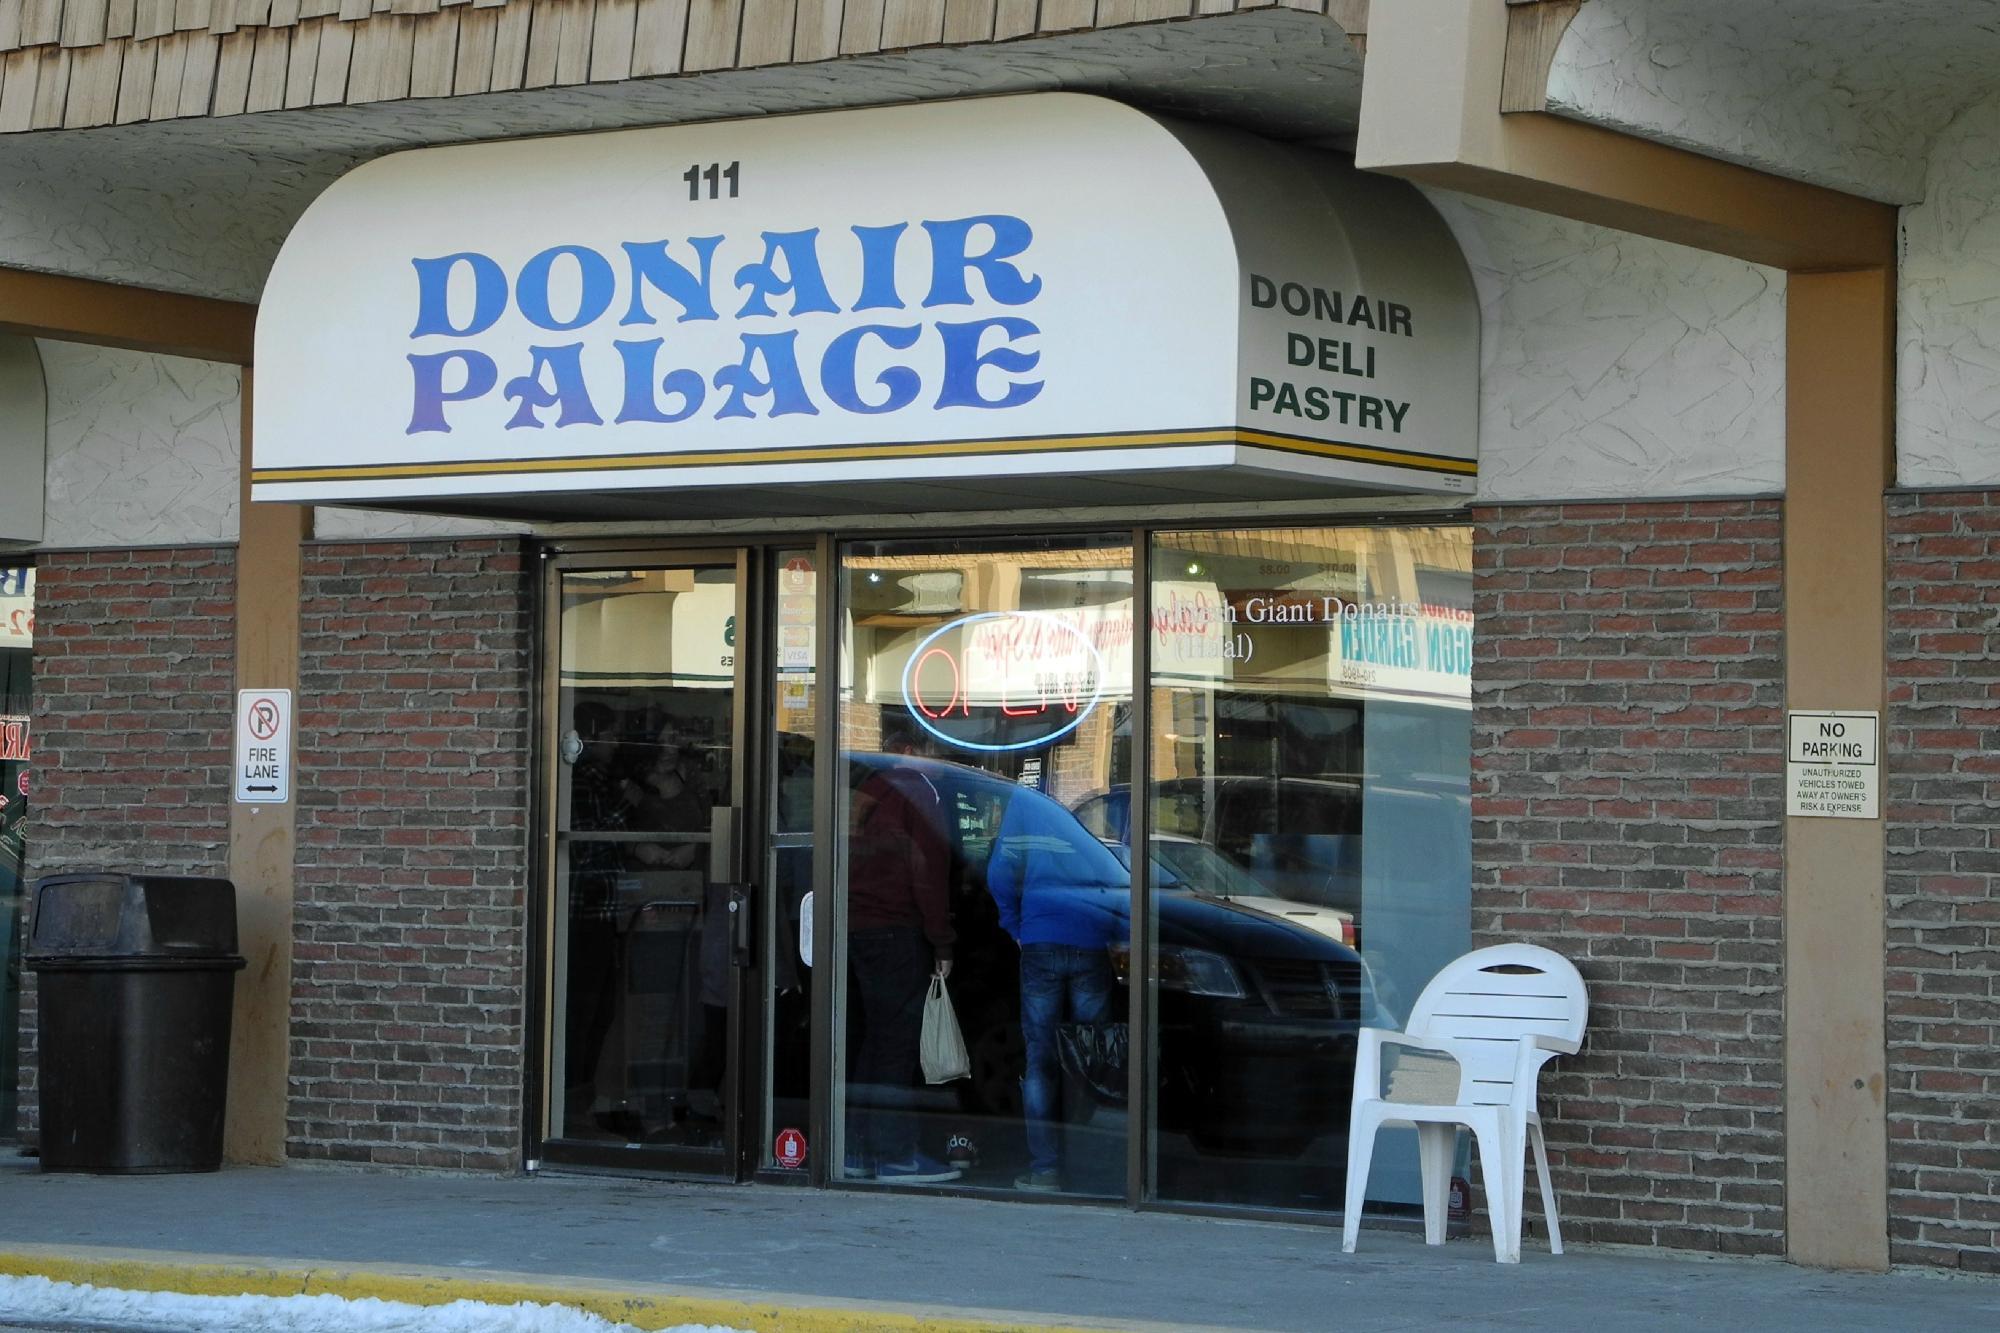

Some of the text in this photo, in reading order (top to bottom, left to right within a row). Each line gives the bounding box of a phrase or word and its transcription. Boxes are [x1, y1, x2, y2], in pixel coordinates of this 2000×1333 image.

[684, 161, 739, 201] 111
[409, 215, 1042, 338] DONAIR
[1250, 273, 1414, 337] DONAIR
[1287, 332, 1375, 379] DELI
[405, 316, 1045, 436] PALACE
[1250, 377, 1411, 433] PASTRY
[1245, 597, 1315, 623] Giant
[1321, 596, 1419, 623] Donairs
[787, 650, 808, 661] VISA
[1820, 723, 1845, 737] NO
[248, 748, 277, 762] FIRE
[1802, 742, 1862, 758] PARKING
[245, 765, 279, 779] LANE
[1802, 768, 1862, 778] UNAUTHORIZED
[1798, 780, 1865, 790] VEHICLES TOWED
[1797, 791, 1867, 801] AWAY AT OWNER'S
[1801, 802, 1862, 813] RISK & EXPENSE
